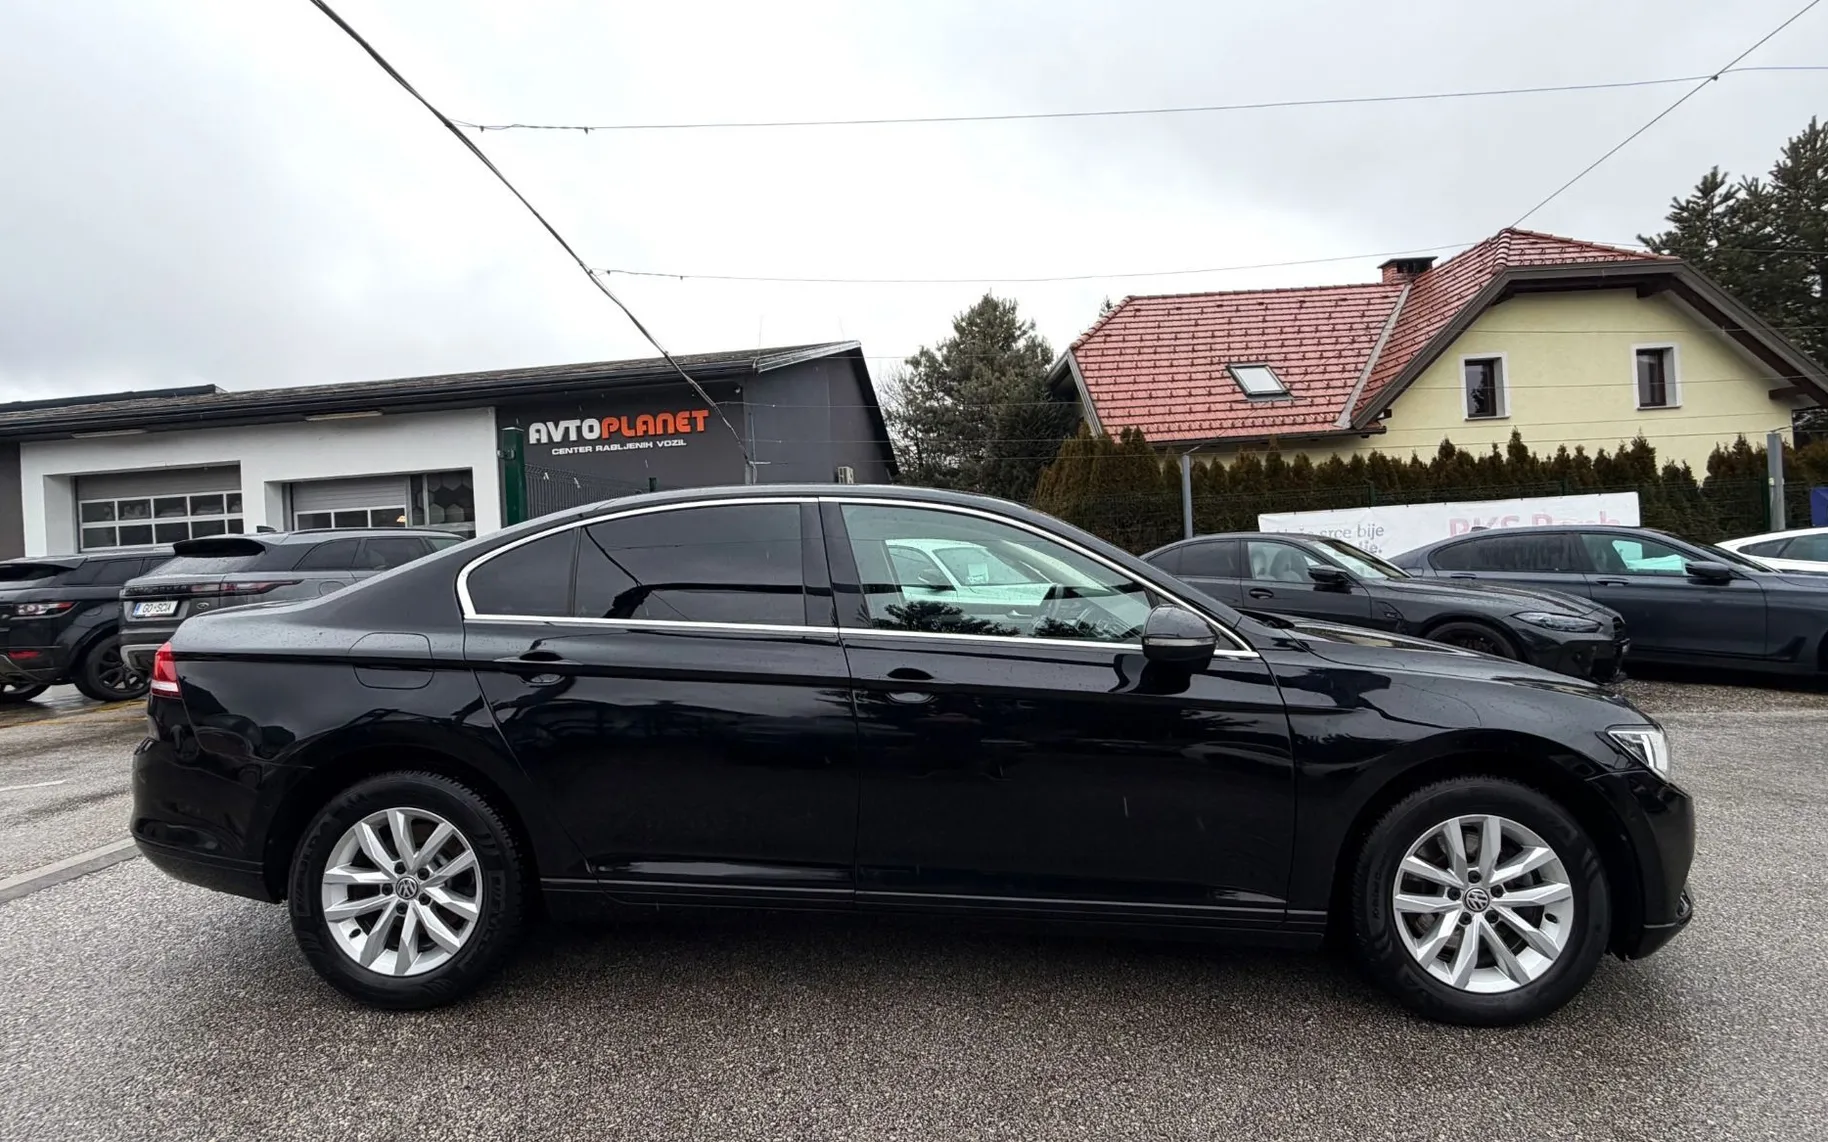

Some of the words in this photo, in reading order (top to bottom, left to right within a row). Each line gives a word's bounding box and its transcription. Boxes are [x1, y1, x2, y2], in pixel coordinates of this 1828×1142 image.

[529, 410, 709, 444] AVTOPLANET
[552, 446, 592, 456] CENTER
[595, 442, 653, 452] RABLJENIH
[656, 439, 687, 448] VOZIL
[1357, 523, 1385, 541] bije
